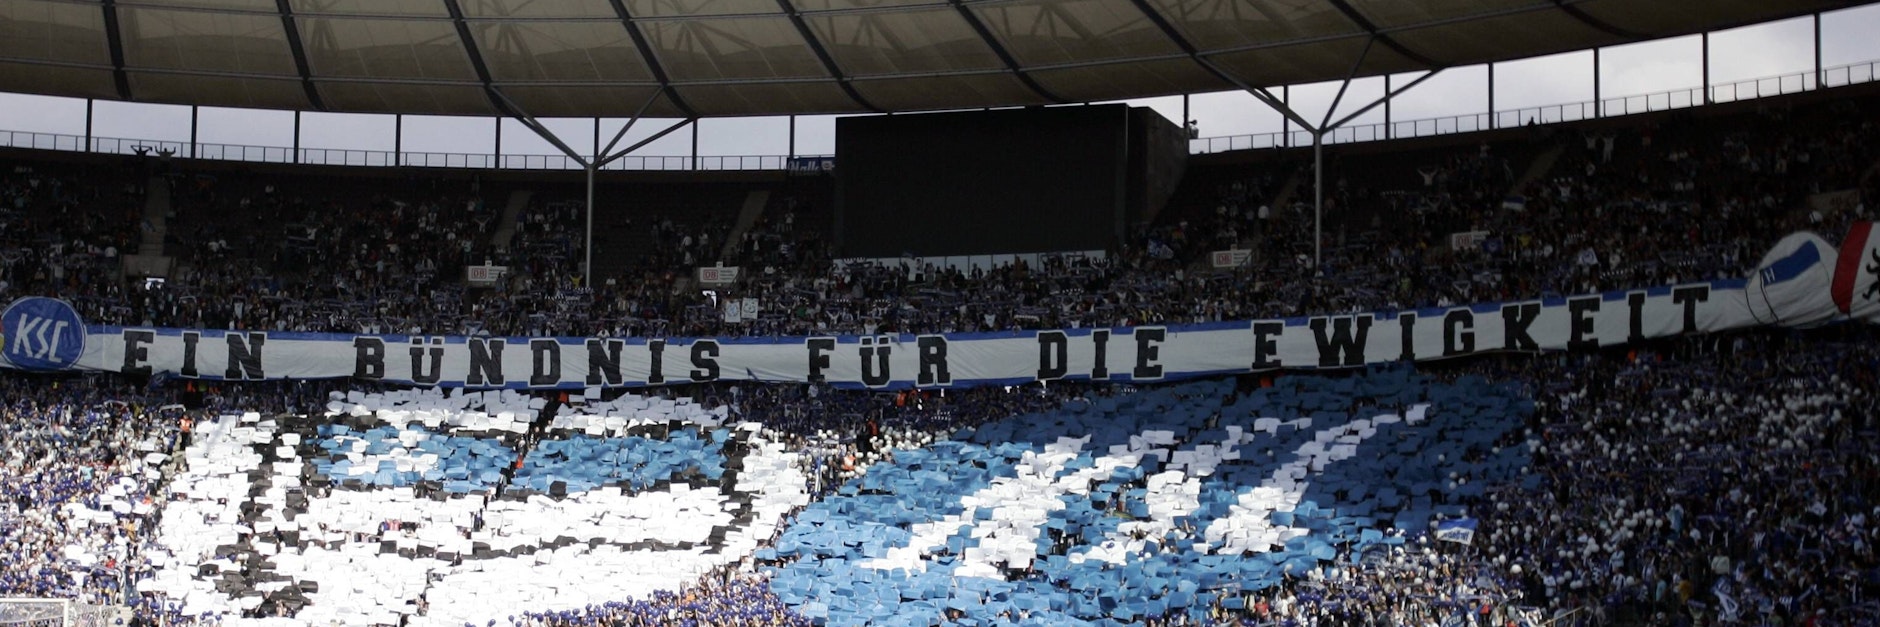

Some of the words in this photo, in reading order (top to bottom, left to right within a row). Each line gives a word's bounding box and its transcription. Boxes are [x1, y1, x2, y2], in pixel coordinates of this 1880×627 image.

[12, 313, 68, 363] KSC
[121, 331, 265, 378] EIN
[354, 338, 720, 385] BÜNDNIS
[807, 336, 951, 386] FÜR
[1037, 328, 1166, 379] DIE
[1252, 286, 1710, 368] EWIGKEIT
